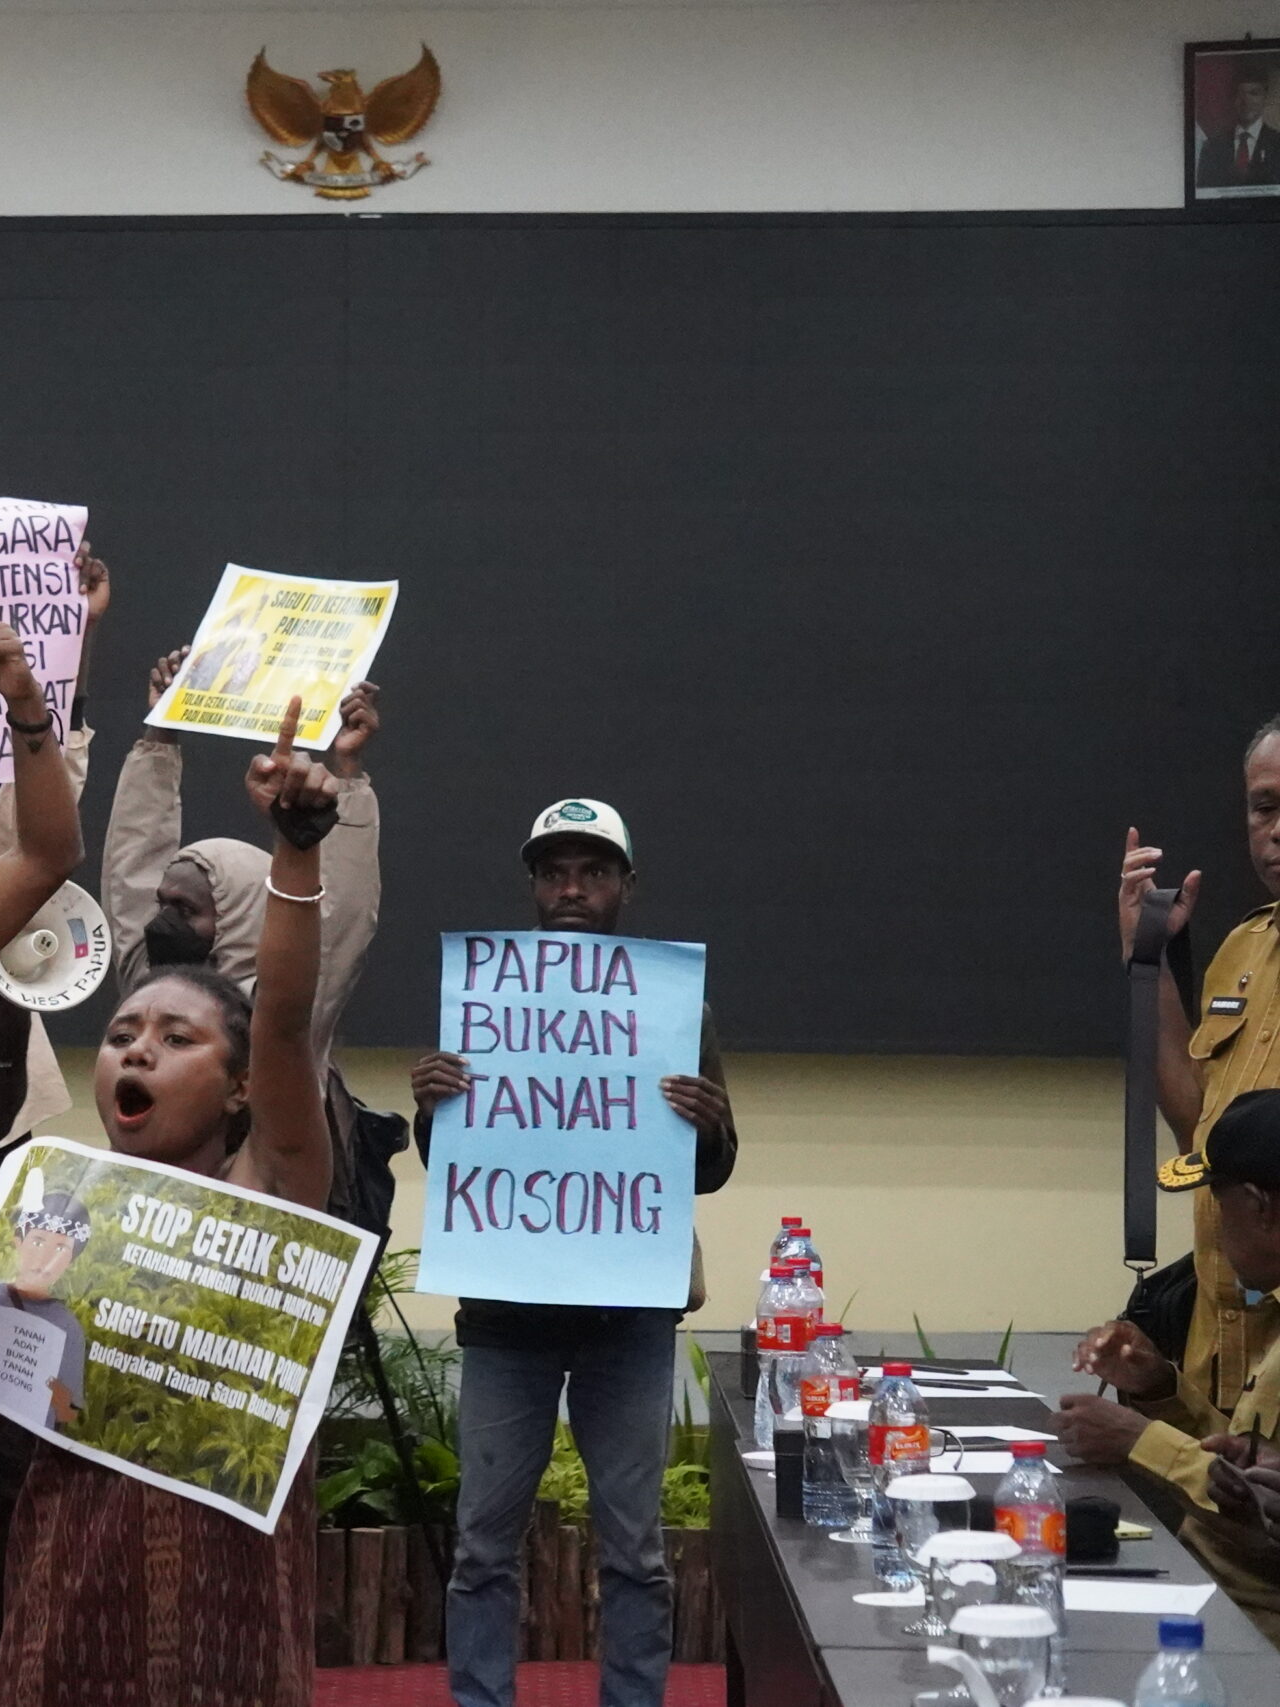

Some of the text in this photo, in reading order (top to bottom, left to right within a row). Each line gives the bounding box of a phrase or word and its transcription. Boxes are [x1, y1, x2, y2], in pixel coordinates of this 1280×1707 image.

[271, 590, 385, 616] SAGU ITU KETAHANAN
[274, 616, 324, 637] PANGAN
[22, 641, 45, 671] SI
[43, 679, 75, 710] AT
[74, 923, 107, 992] PAPUA
[463, 936, 638, 995] PAPUA
[458, 1001, 638, 1057] BUKAN
[464, 1073, 637, 1131] TANAH
[443, 1162, 662, 1235] KOSONG
[121, 1194, 348, 1304] STOP CETAK SAWAH
[122, 1242, 193, 1281] KETAHANAN
[190, 1264, 242, 1297] PANGAN
[240, 1279, 283, 1310] BUKAN
[6, 1348, 38, 1367] BUKAN
[12, 1338, 40, 1353] ADAT
[13, 1325, 46, 1345] TANAH
[94, 1297, 308, 1397] SAGU ITU MAKANAN POKOK
[2, 1359, 34, 1379] TANAH
[88, 1340, 164, 1384] Budayakan
[164, 1365, 211, 1399] Tanam
[211, 1381, 248, 1411] Sagu
[247, 1393, 277, 1423] Bukan
